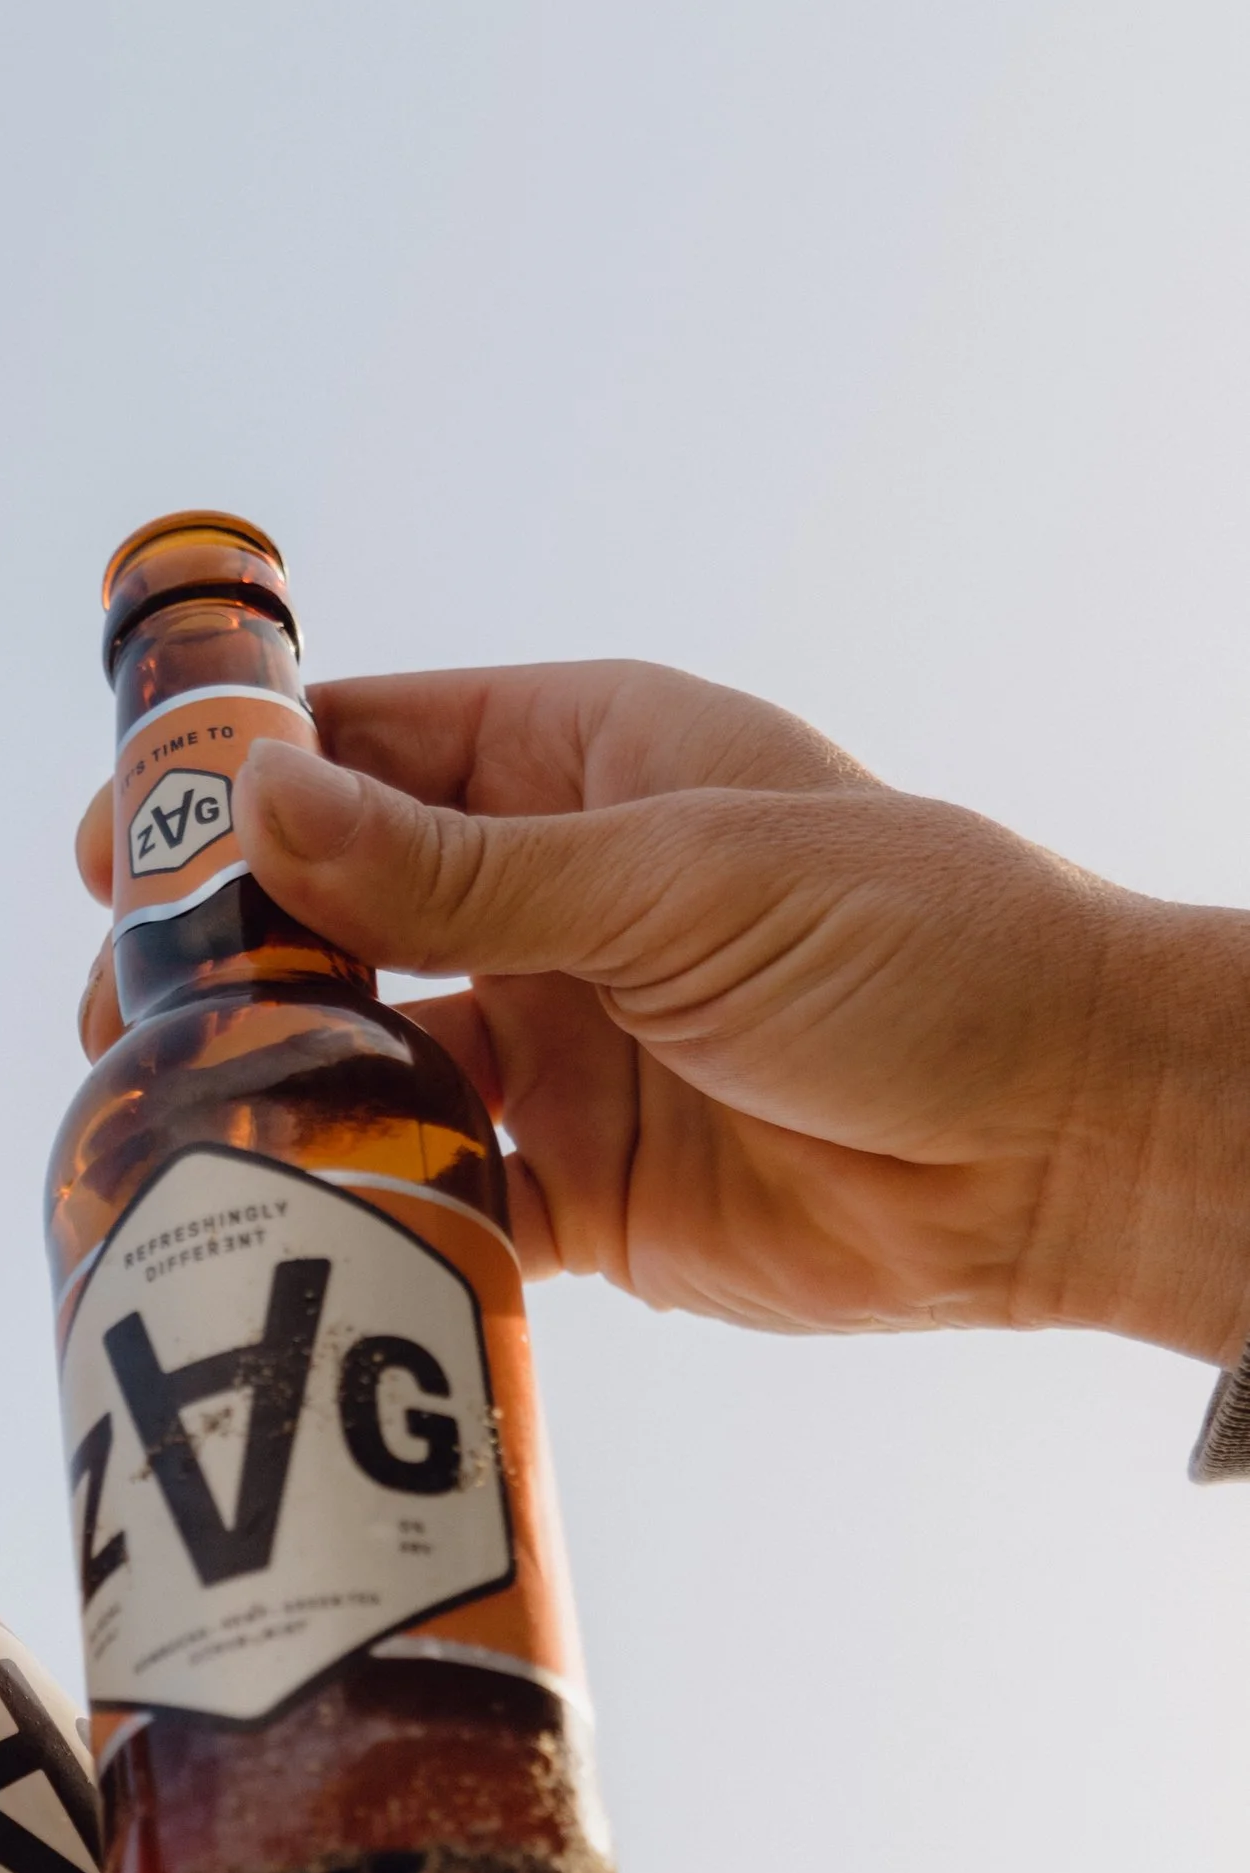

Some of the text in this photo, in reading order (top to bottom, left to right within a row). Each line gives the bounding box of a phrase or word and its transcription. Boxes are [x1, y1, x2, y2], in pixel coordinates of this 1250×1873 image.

[152, 731, 198, 762] TIME
[207, 726, 234, 740] TO
[124, 1200, 289, 1270] REFRESHINGLY
